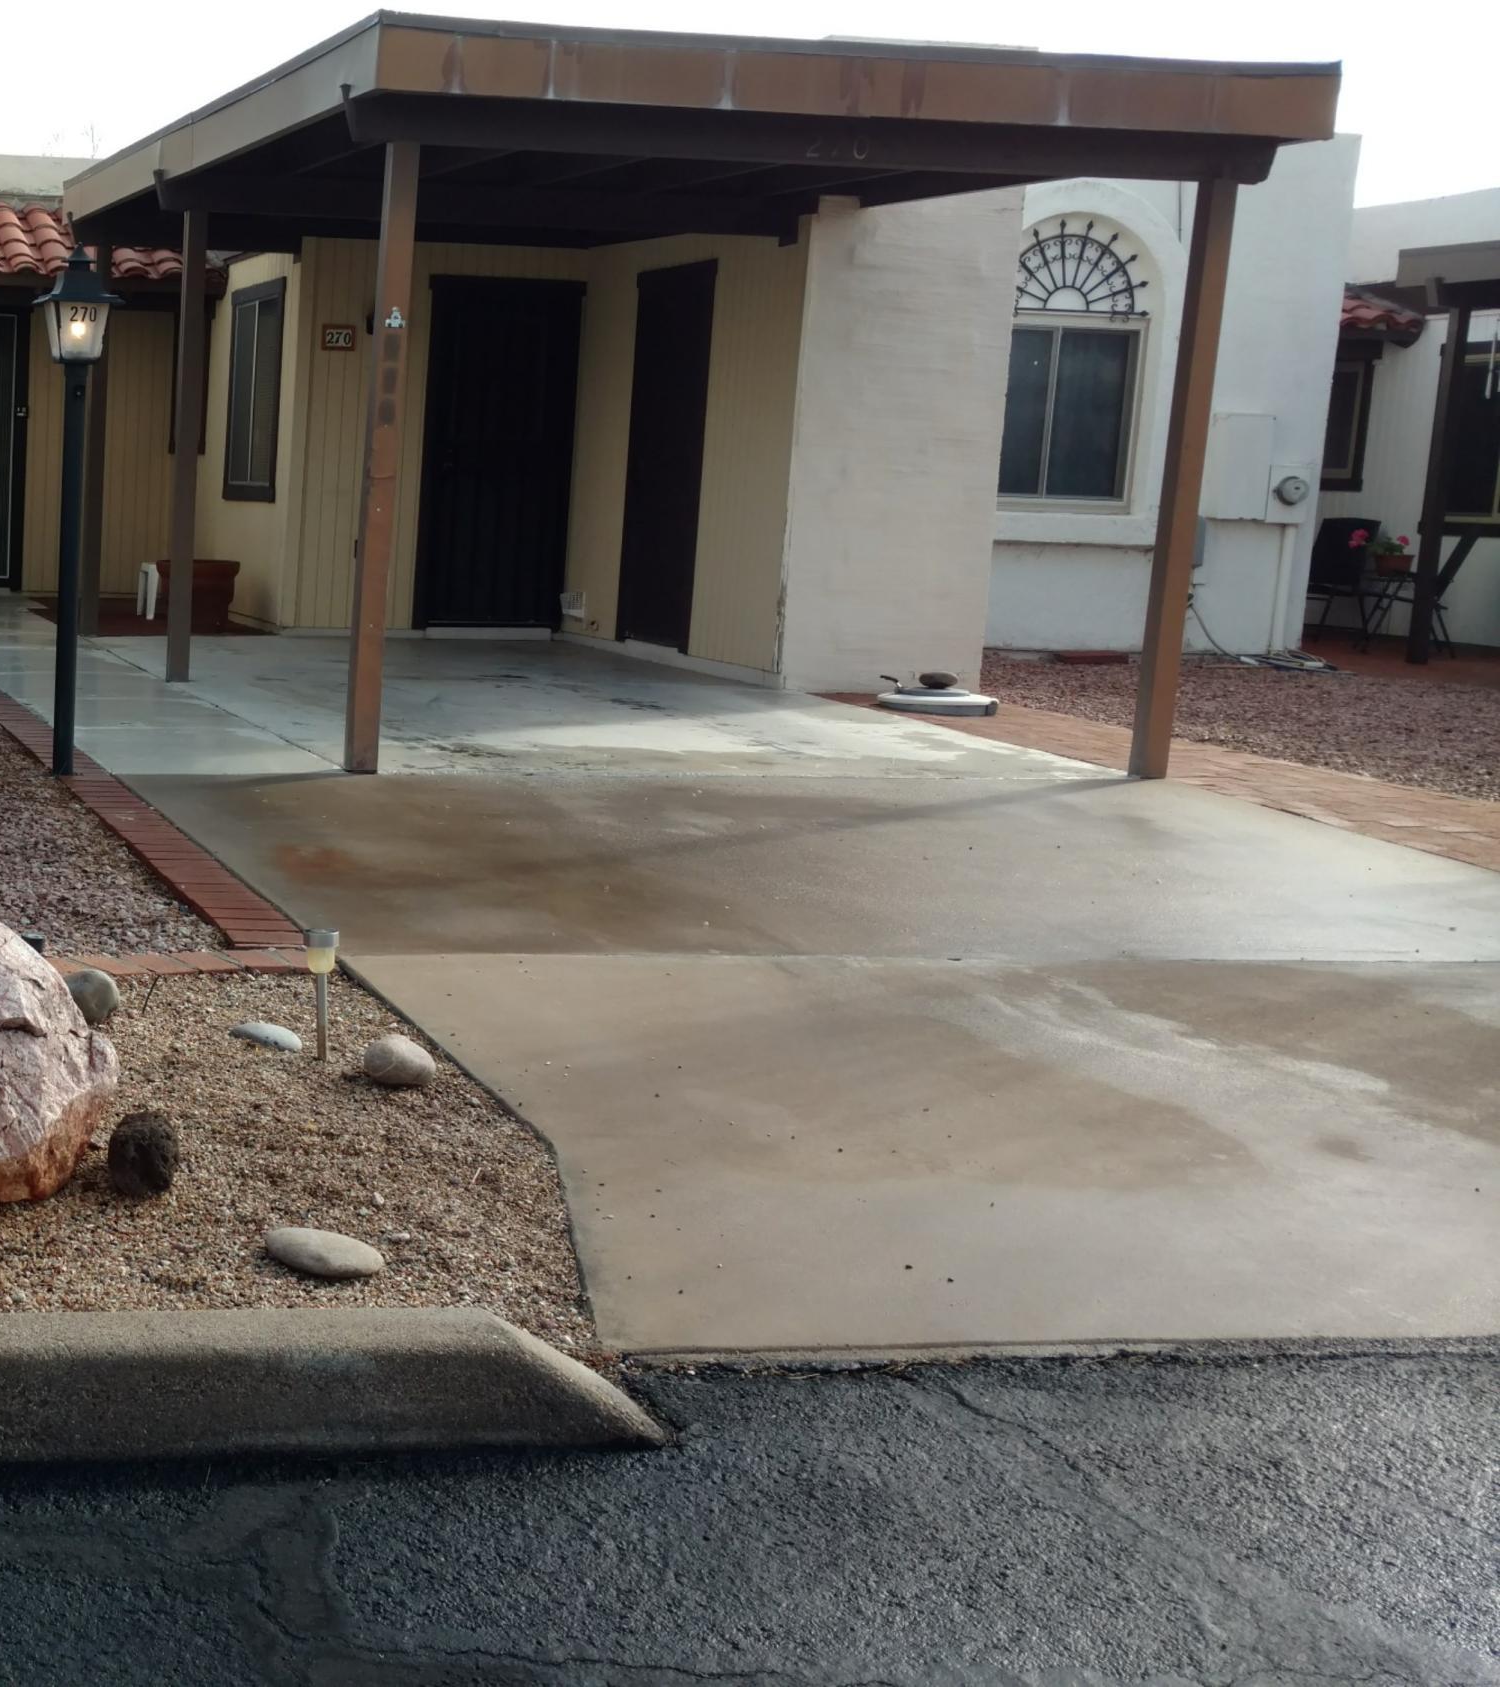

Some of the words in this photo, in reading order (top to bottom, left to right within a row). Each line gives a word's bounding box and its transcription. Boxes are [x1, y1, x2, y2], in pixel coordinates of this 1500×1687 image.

[805, 135, 870, 161] 20
[69, 306, 97, 322] 270
[326, 331, 352, 346] 270
